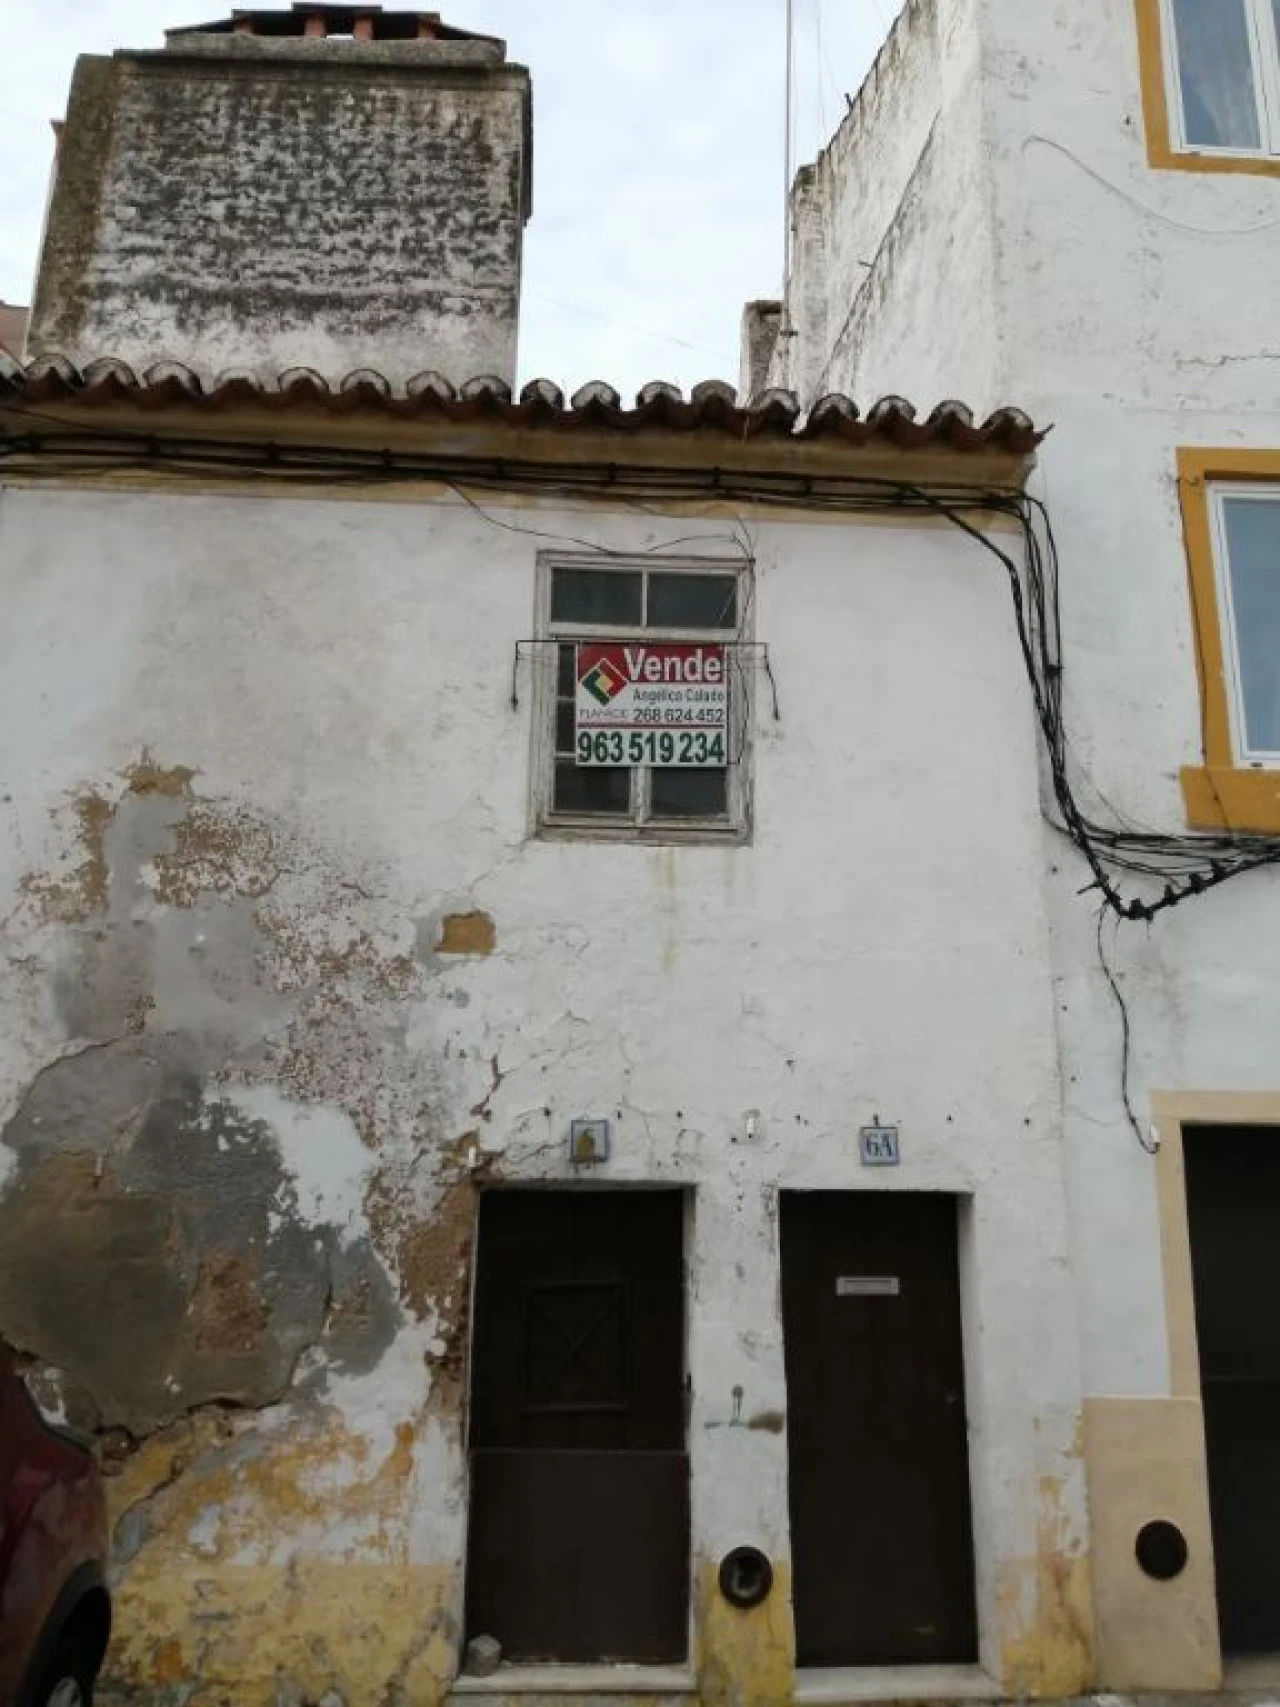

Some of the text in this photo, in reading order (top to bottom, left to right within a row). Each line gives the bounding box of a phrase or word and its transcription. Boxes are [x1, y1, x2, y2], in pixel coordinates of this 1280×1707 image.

[623, 648, 722, 681] Vende
[633, 708, 725, 722] 268 624 452
[578, 731, 725, 763] 963 519 234
[865, 1133, 893, 1158] 6A
